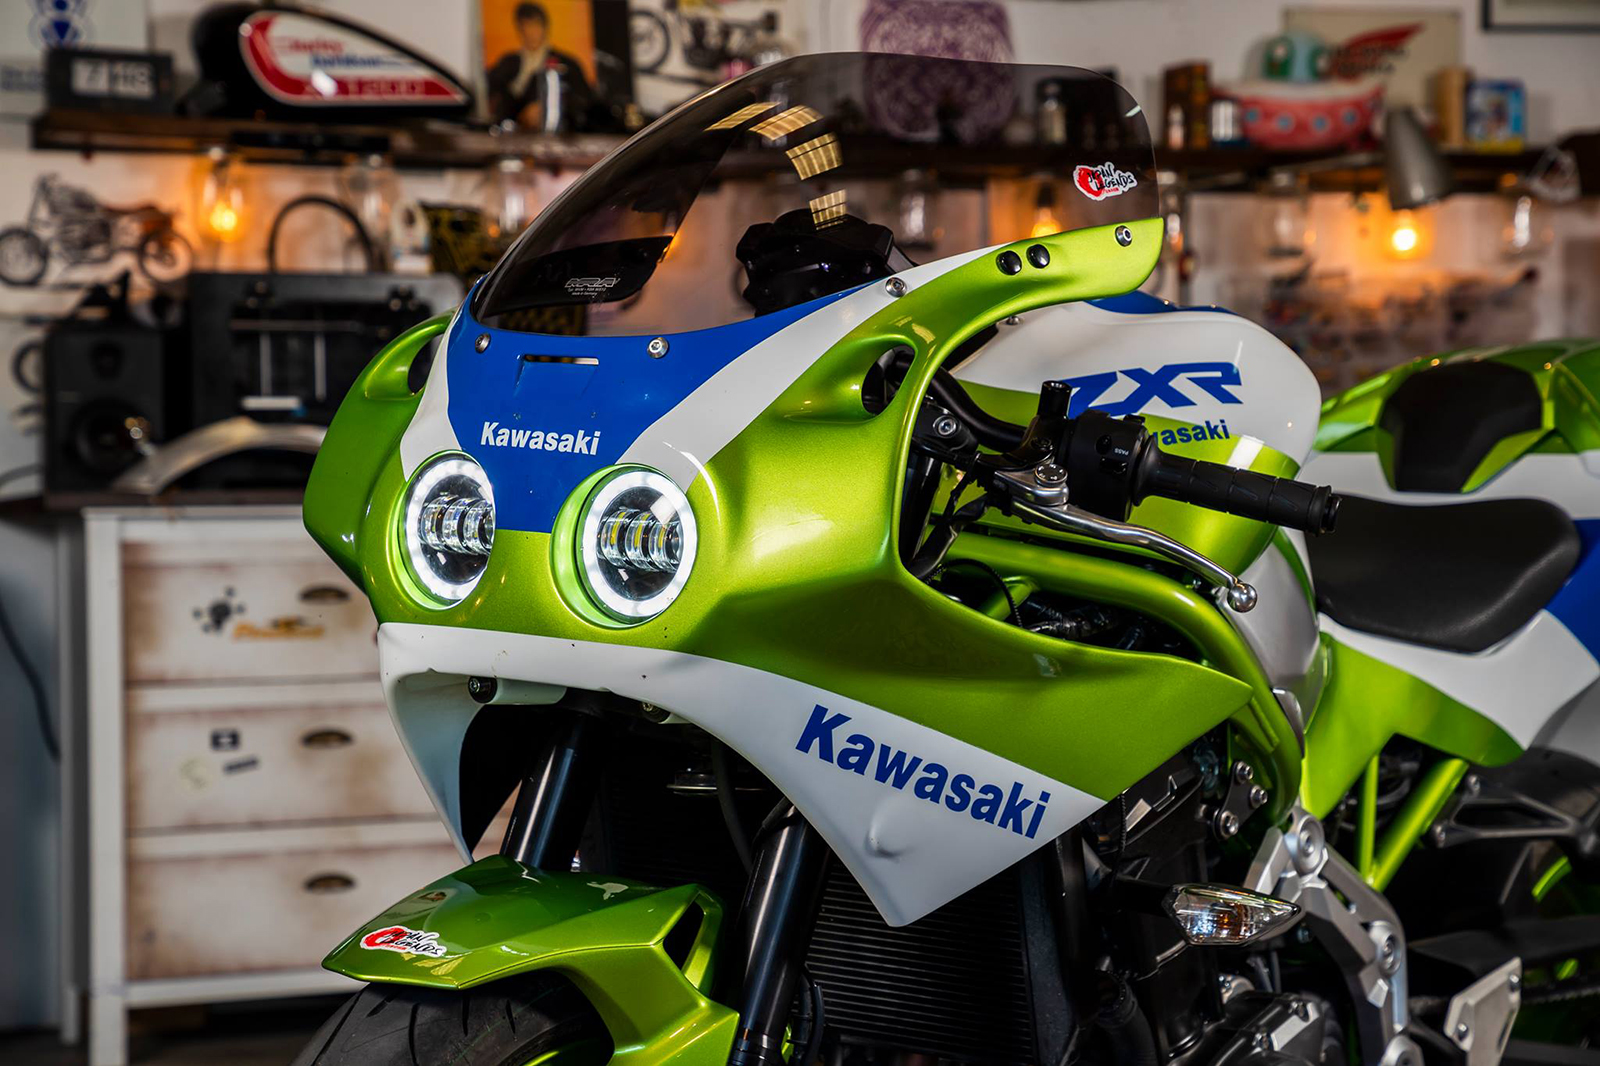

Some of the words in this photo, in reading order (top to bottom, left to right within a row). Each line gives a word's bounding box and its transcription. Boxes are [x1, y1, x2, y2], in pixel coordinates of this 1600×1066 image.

[1094, 173, 1135, 191] LEGENDS
[1060, 362, 1244, 420] ZXR
[480, 421, 601, 456] Kawasaki
[795, 704, 1051, 840] Kawasaki
